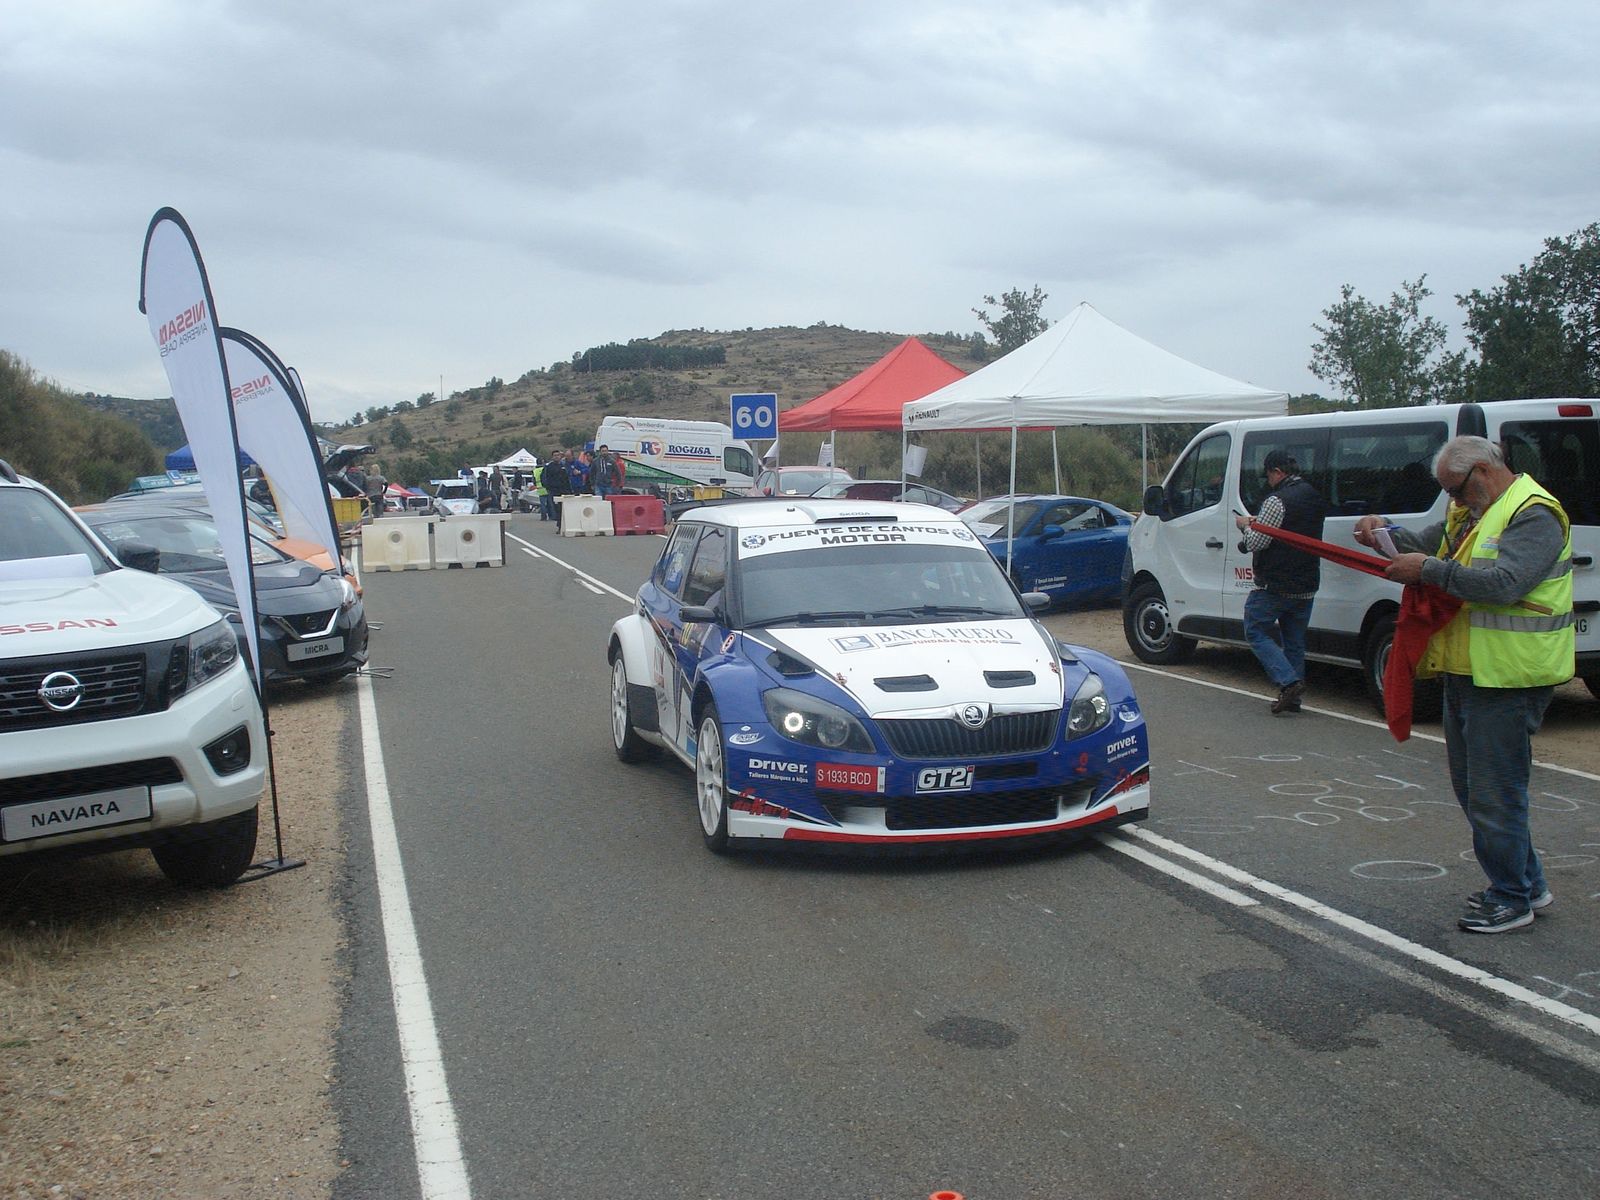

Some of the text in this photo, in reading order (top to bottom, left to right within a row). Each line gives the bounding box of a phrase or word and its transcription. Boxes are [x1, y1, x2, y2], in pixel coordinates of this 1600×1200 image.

[736, 406, 773, 428] 60
[914, 409, 940, 420] RENAULT
[668, 444, 712, 455] ROGUSA
[768, 527, 843, 541] FUENTE
[877, 526, 951, 535] CANTOS
[821, 533, 907, 545] MOTOR
[875, 627, 1014, 643] BANCA PUEYO
[304, 644, 329, 655] MICRA
[817, 768, 824, 781] S
[826, 769, 848, 784] 1933
[850, 771, 872, 785] BCD
[917, 765, 975, 789] GT2i
[31, 801, 121, 828] NAVARA
